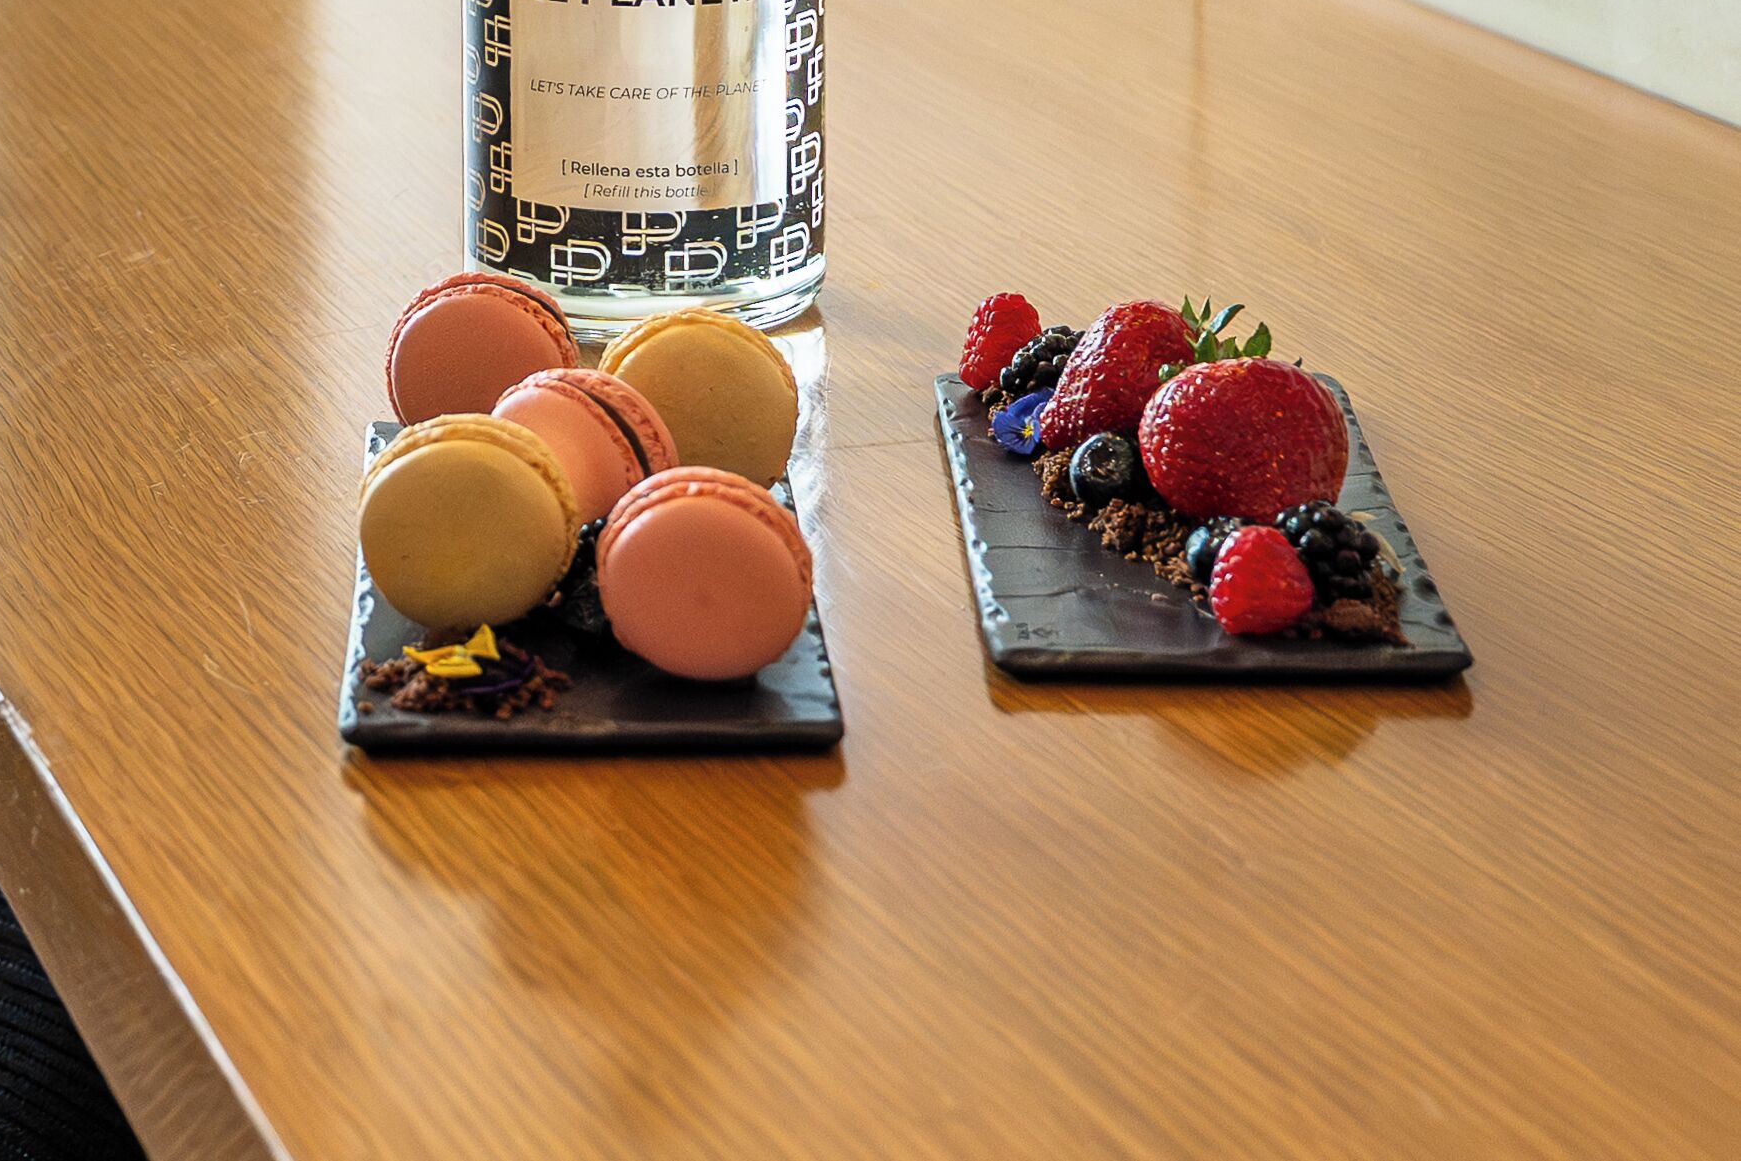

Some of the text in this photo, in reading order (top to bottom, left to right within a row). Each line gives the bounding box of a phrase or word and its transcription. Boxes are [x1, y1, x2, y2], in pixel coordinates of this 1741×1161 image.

[530, 79, 564, 95] LET'S
[567, 83, 606, 99] TAKE
[609, 87, 652, 100] CARE
[656, 87, 679, 100] OF
[683, 85, 712, 99] THE
[570, 161, 631, 177] Rellena
[635, 166, 670, 178] esta
[675, 162, 729, 177] botella
[592, 184, 631, 198] Refill
[634, 186, 661, 199] this
[665, 184, 709, 198] bottle
